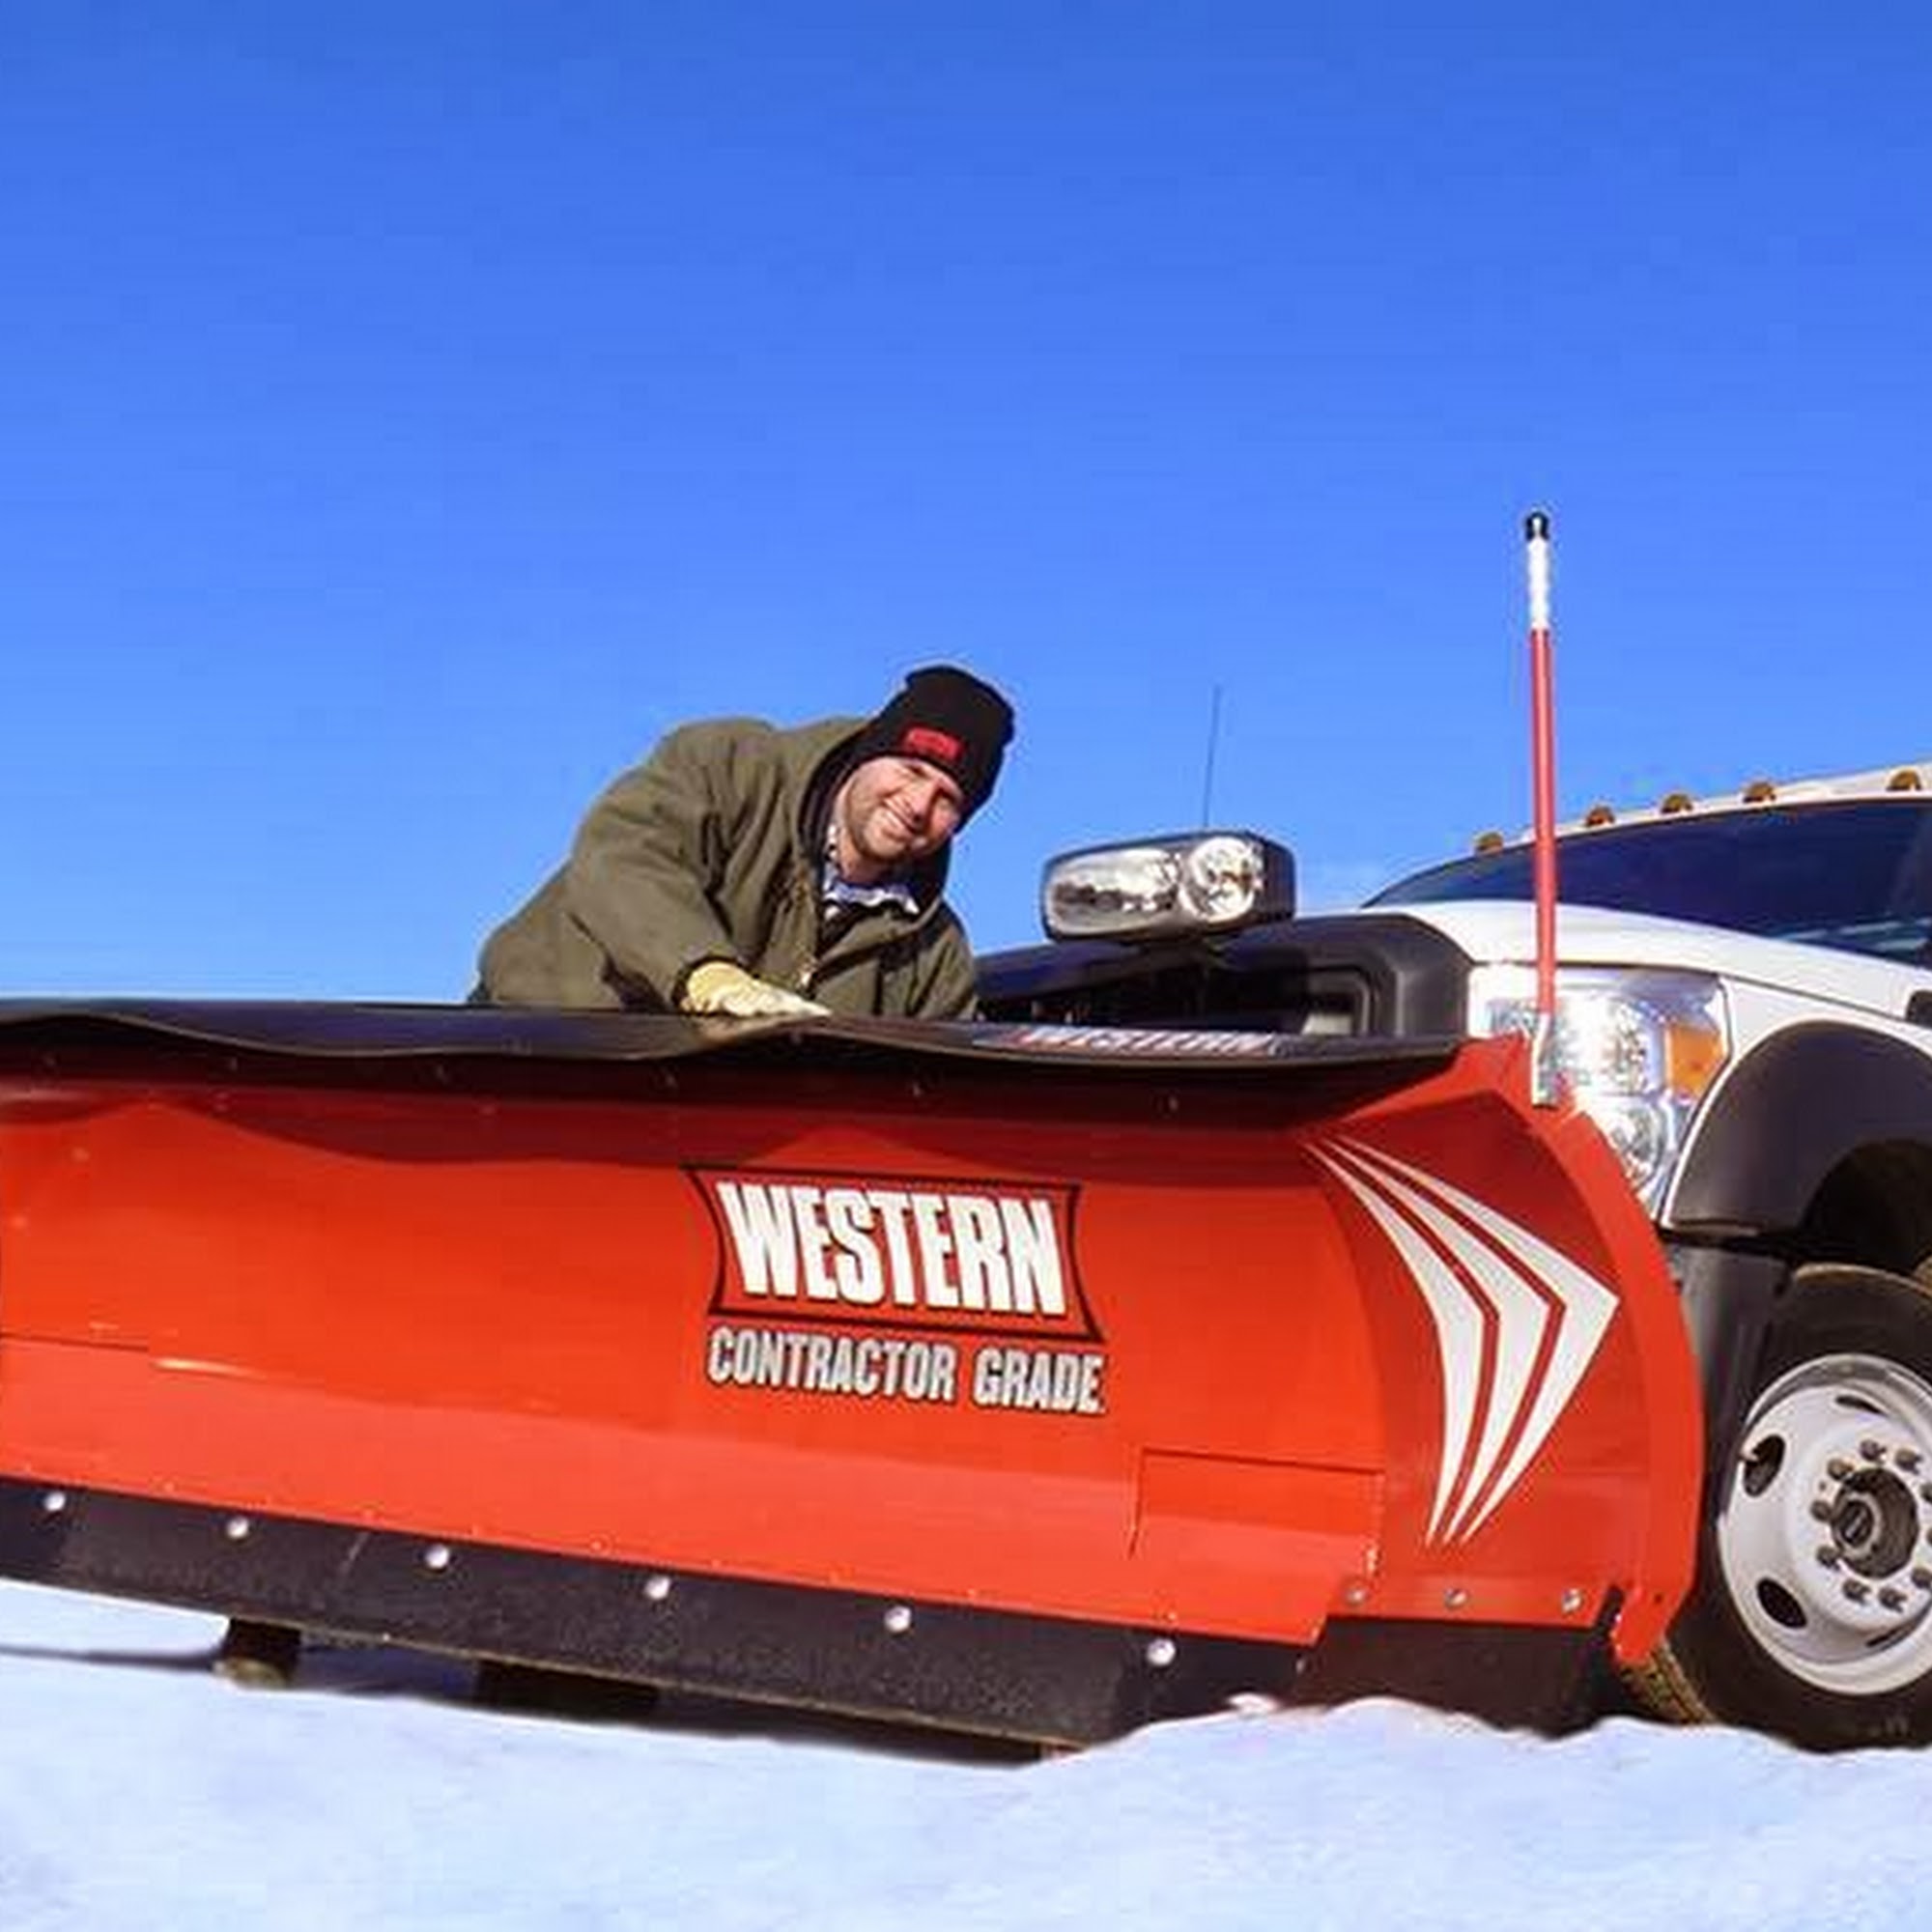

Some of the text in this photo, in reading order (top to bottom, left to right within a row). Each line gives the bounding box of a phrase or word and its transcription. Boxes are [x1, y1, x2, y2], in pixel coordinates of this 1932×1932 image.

[716, 1181, 1066, 1317] WESTERN
[707, 1326, 1106, 1414] CONTRACTOR GRADE
